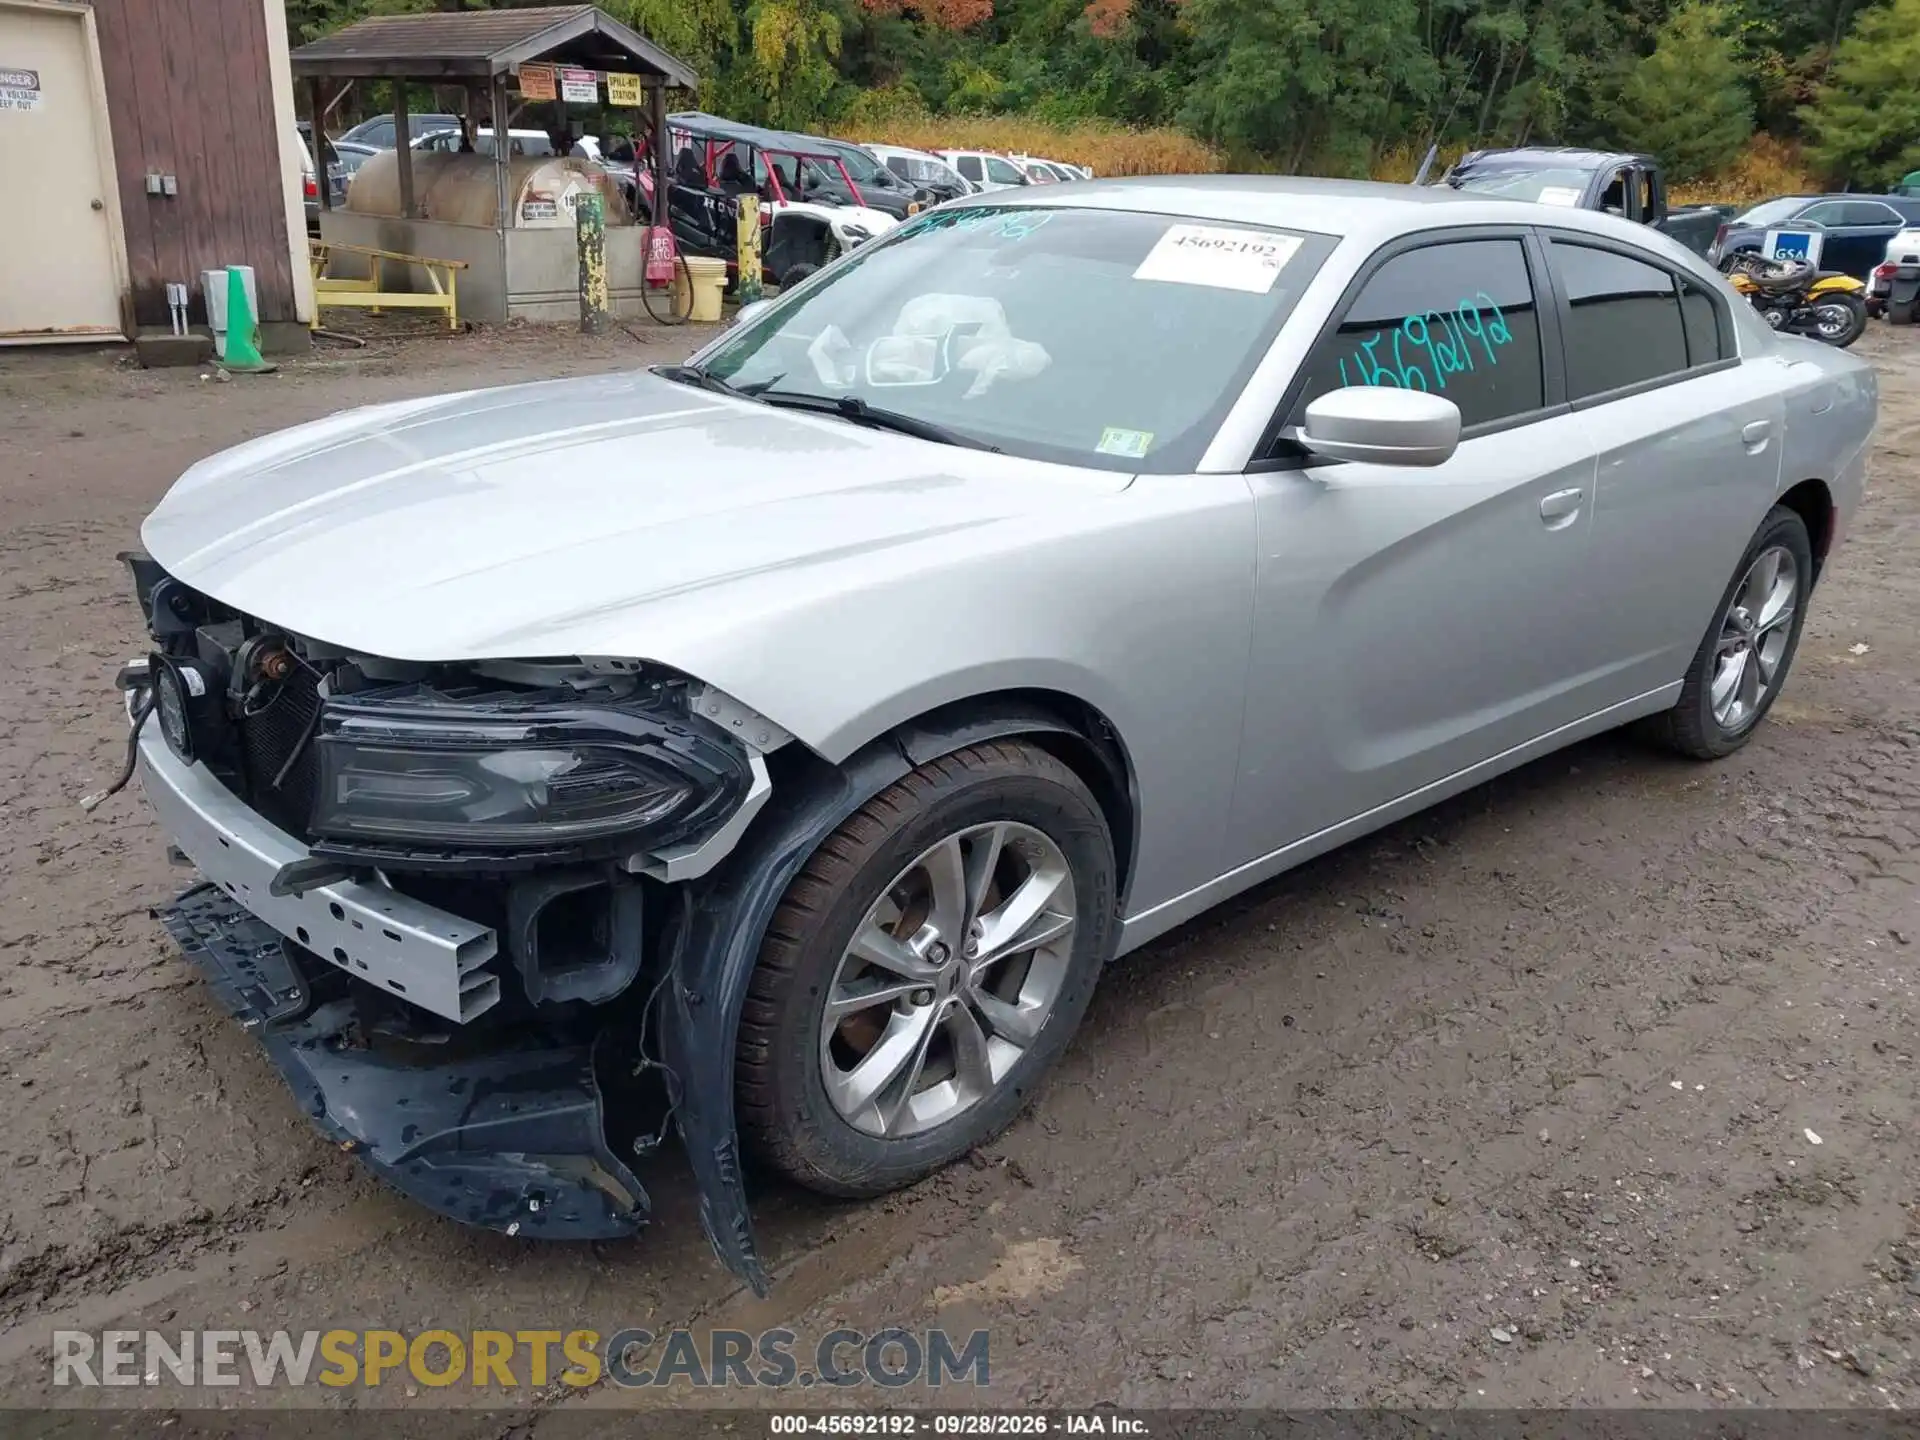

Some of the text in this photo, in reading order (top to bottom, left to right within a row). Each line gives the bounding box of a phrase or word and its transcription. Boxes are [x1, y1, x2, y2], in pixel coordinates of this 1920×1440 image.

[612, 90, 637, 101] STATION
[1172, 235, 1277, 257] 45692192
[1775, 248, 1804, 260] GSA
